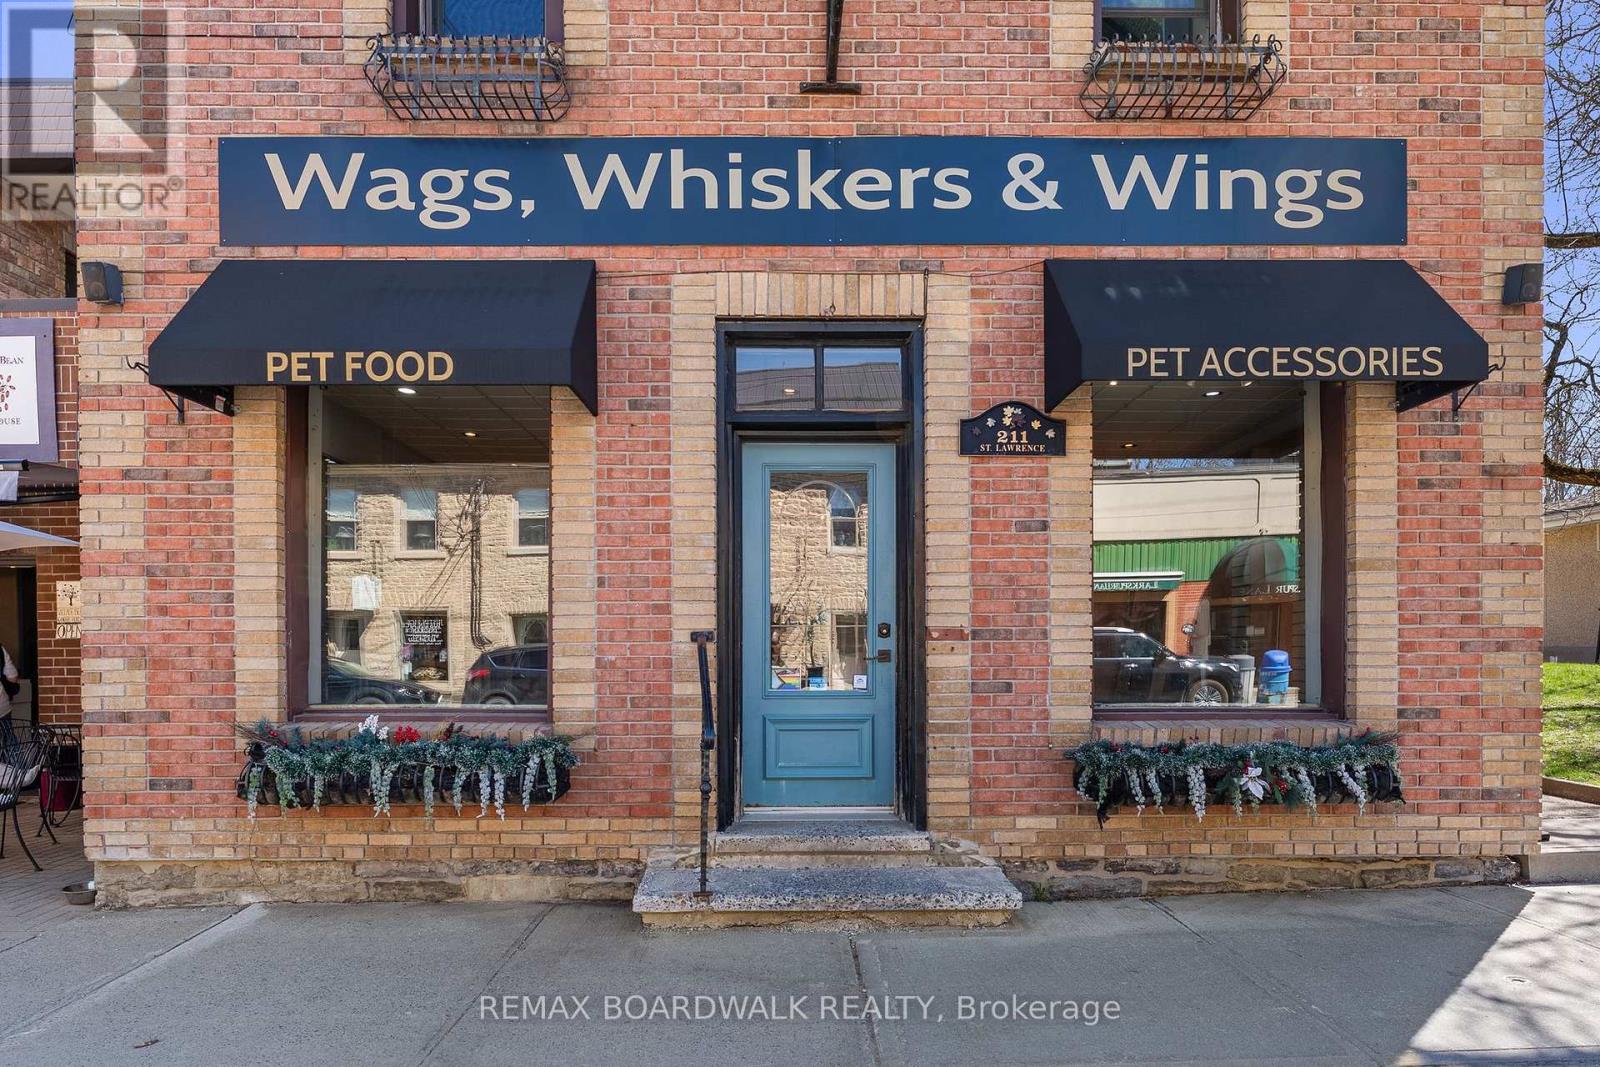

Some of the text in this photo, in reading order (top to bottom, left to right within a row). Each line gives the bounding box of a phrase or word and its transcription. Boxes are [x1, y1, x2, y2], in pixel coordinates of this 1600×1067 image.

[264, 149, 1364, 229] Wags, Whiskers & Wings
[266, 351, 454, 382] PET FOOD
[1127, 347, 1443, 377] PET ACCESSORIES
[996, 430, 1029, 443] 211
[996, 444, 1046, 452] LAWRENCE
